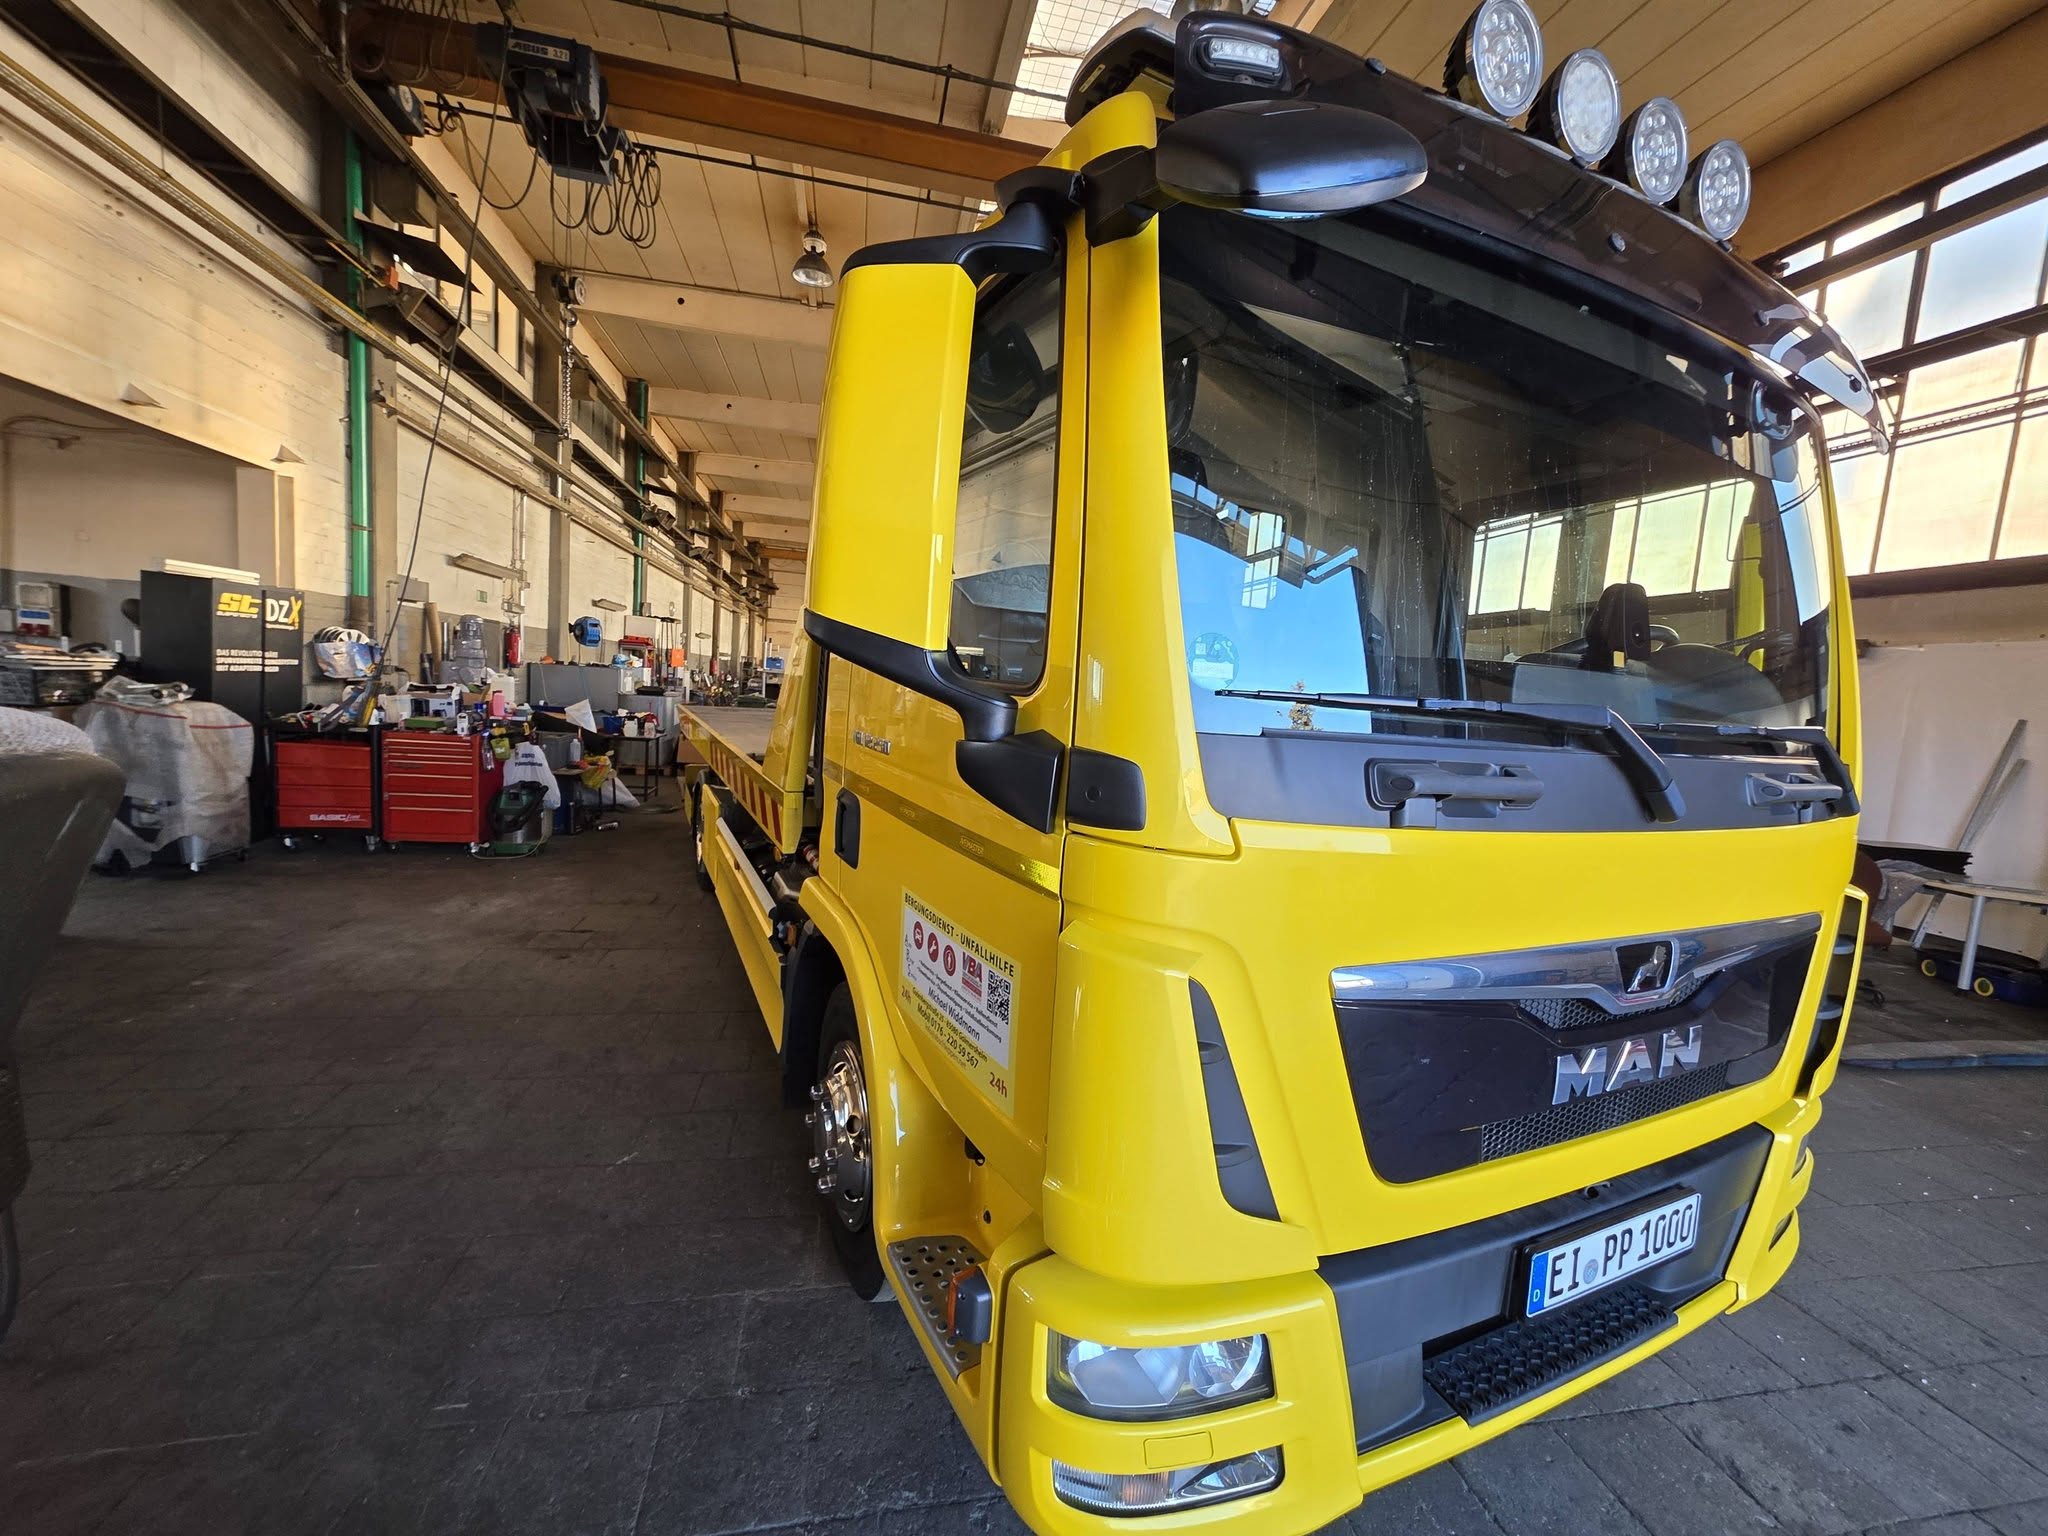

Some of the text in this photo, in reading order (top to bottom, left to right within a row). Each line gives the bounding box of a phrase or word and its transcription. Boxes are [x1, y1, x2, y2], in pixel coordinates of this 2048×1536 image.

[904, 892, 955, 938] BERGUNGSDIENST
[960, 932, 1015, 977] UNFALLHILFE
[901, 985, 912, 1004] 24h
[962, 951, 983, 984] VBA
[917, 1002, 930, 1022] Mobil
[930, 1018, 944, 1037] 0176
[946, 1033, 958, 1050] 220
[958, 1044, 966, 1058] 59
[966, 1051, 979, 1069] 567
[928, 986, 948, 1012] Michael
[948, 1005, 980, 1041] Widdmann
[989, 1072, 1008, 1098] 24h
[1552, 1025, 1702, 1105] MAN
[1533, 1289, 1541, 1303] D
[1548, 1246, 1581, 1300] EI
